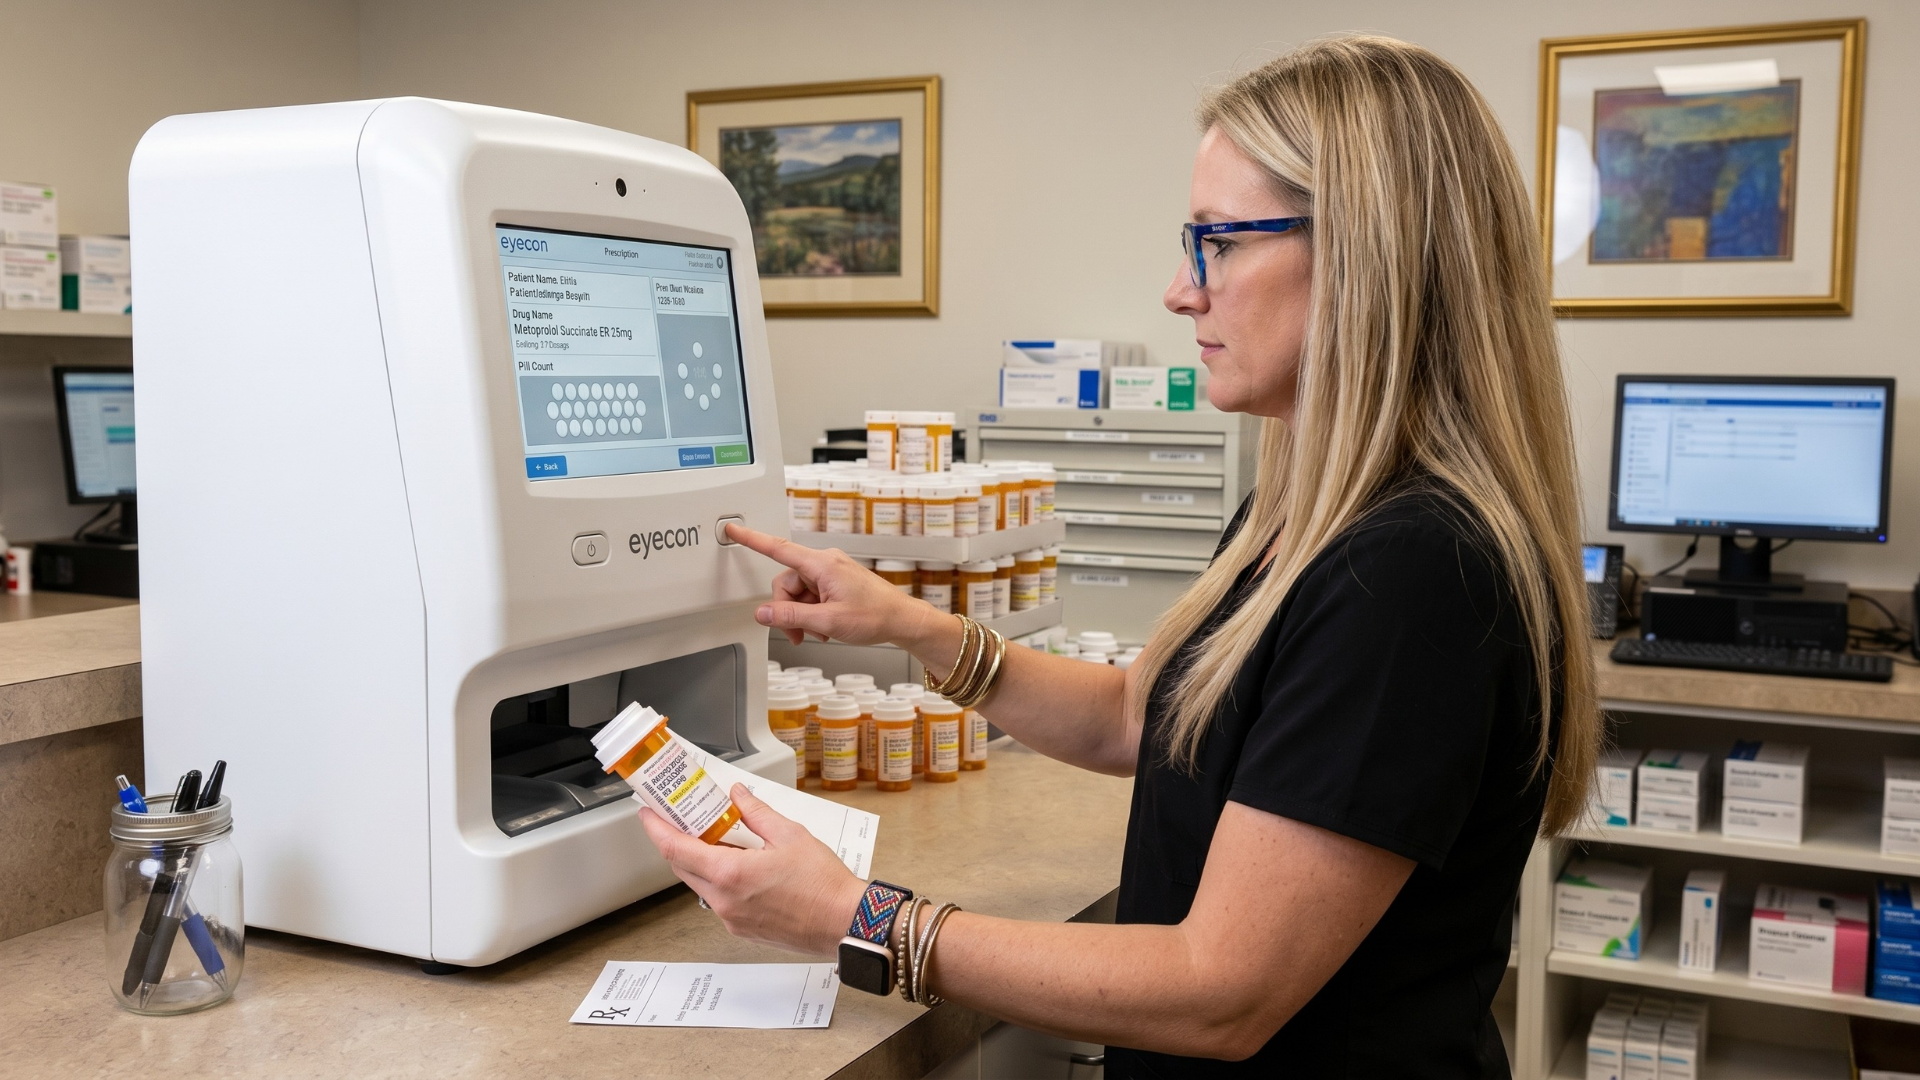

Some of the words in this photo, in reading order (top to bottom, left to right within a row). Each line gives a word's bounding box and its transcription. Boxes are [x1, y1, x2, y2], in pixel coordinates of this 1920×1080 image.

[501, 236, 548, 253] eyecon
[604, 247, 638, 259] Prescription
[508, 272, 535, 283] Patient
[512, 308, 530, 321] Drug
[532, 310, 553, 320] Name
[514, 323, 559, 338] Metoprolol
[560, 325, 598, 337] Succinate
[600, 326, 610, 338] ER
[611, 327, 632, 341] 25mg
[518, 361, 531, 371] Pill
[531, 362, 554, 371] Count
[544, 462, 558, 471] Back
[629, 525, 699, 560] eyecon
